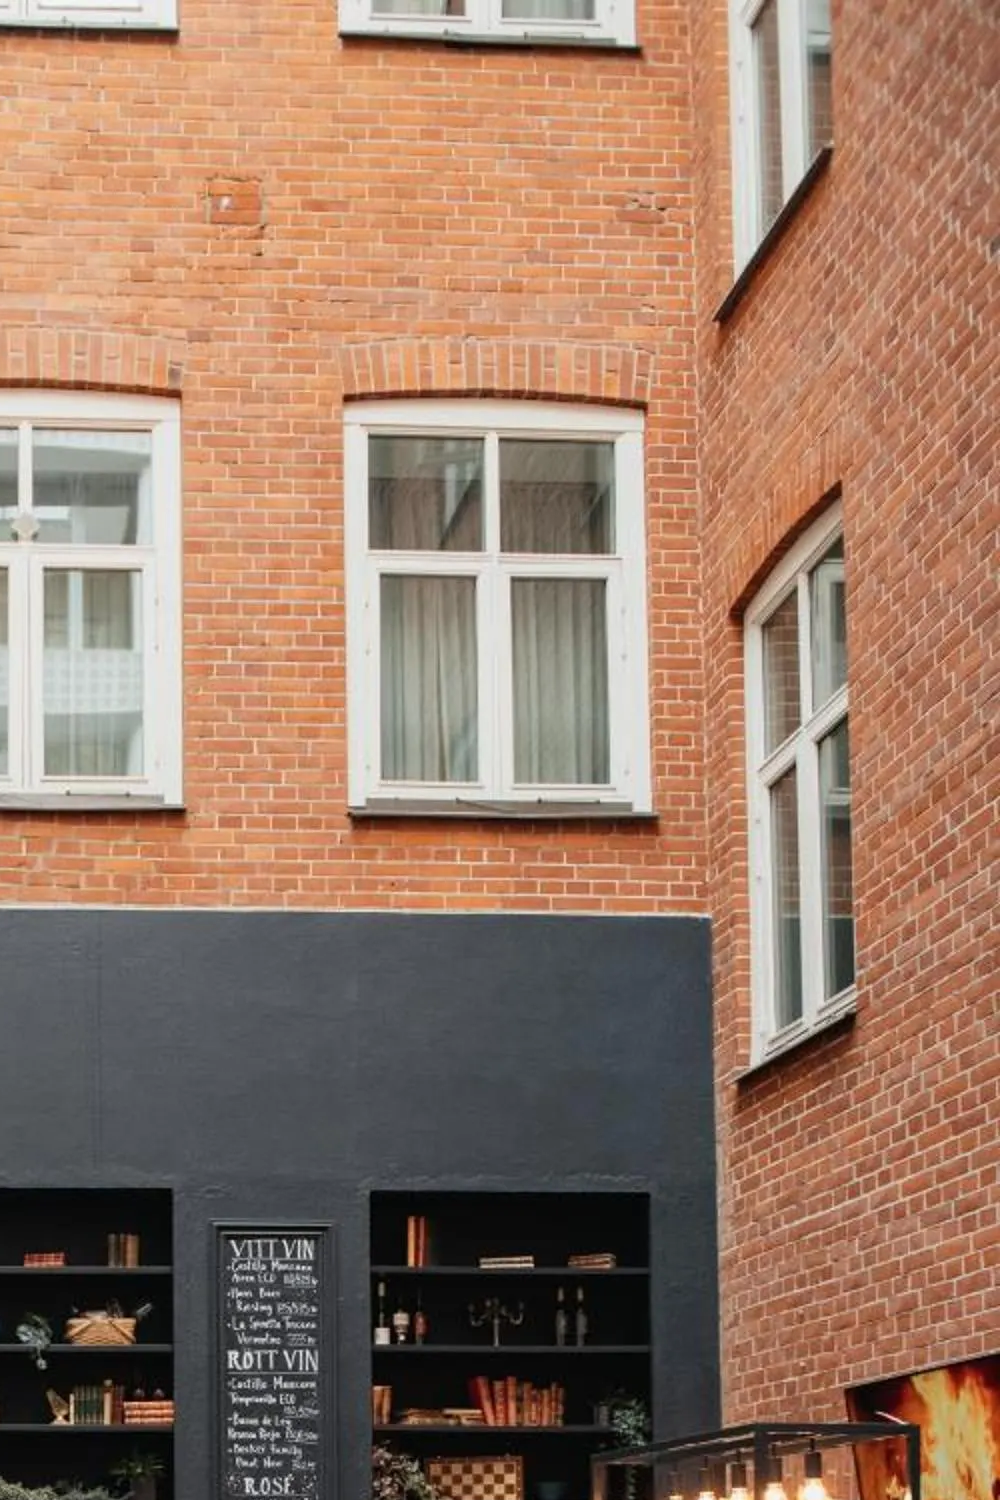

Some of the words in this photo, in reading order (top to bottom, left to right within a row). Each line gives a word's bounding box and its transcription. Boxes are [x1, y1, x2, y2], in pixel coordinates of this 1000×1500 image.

[229, 1239, 279, 1260] VITT
[282, 1238, 315, 1260] VIN
[283, 1348, 319, 1374] VIN
